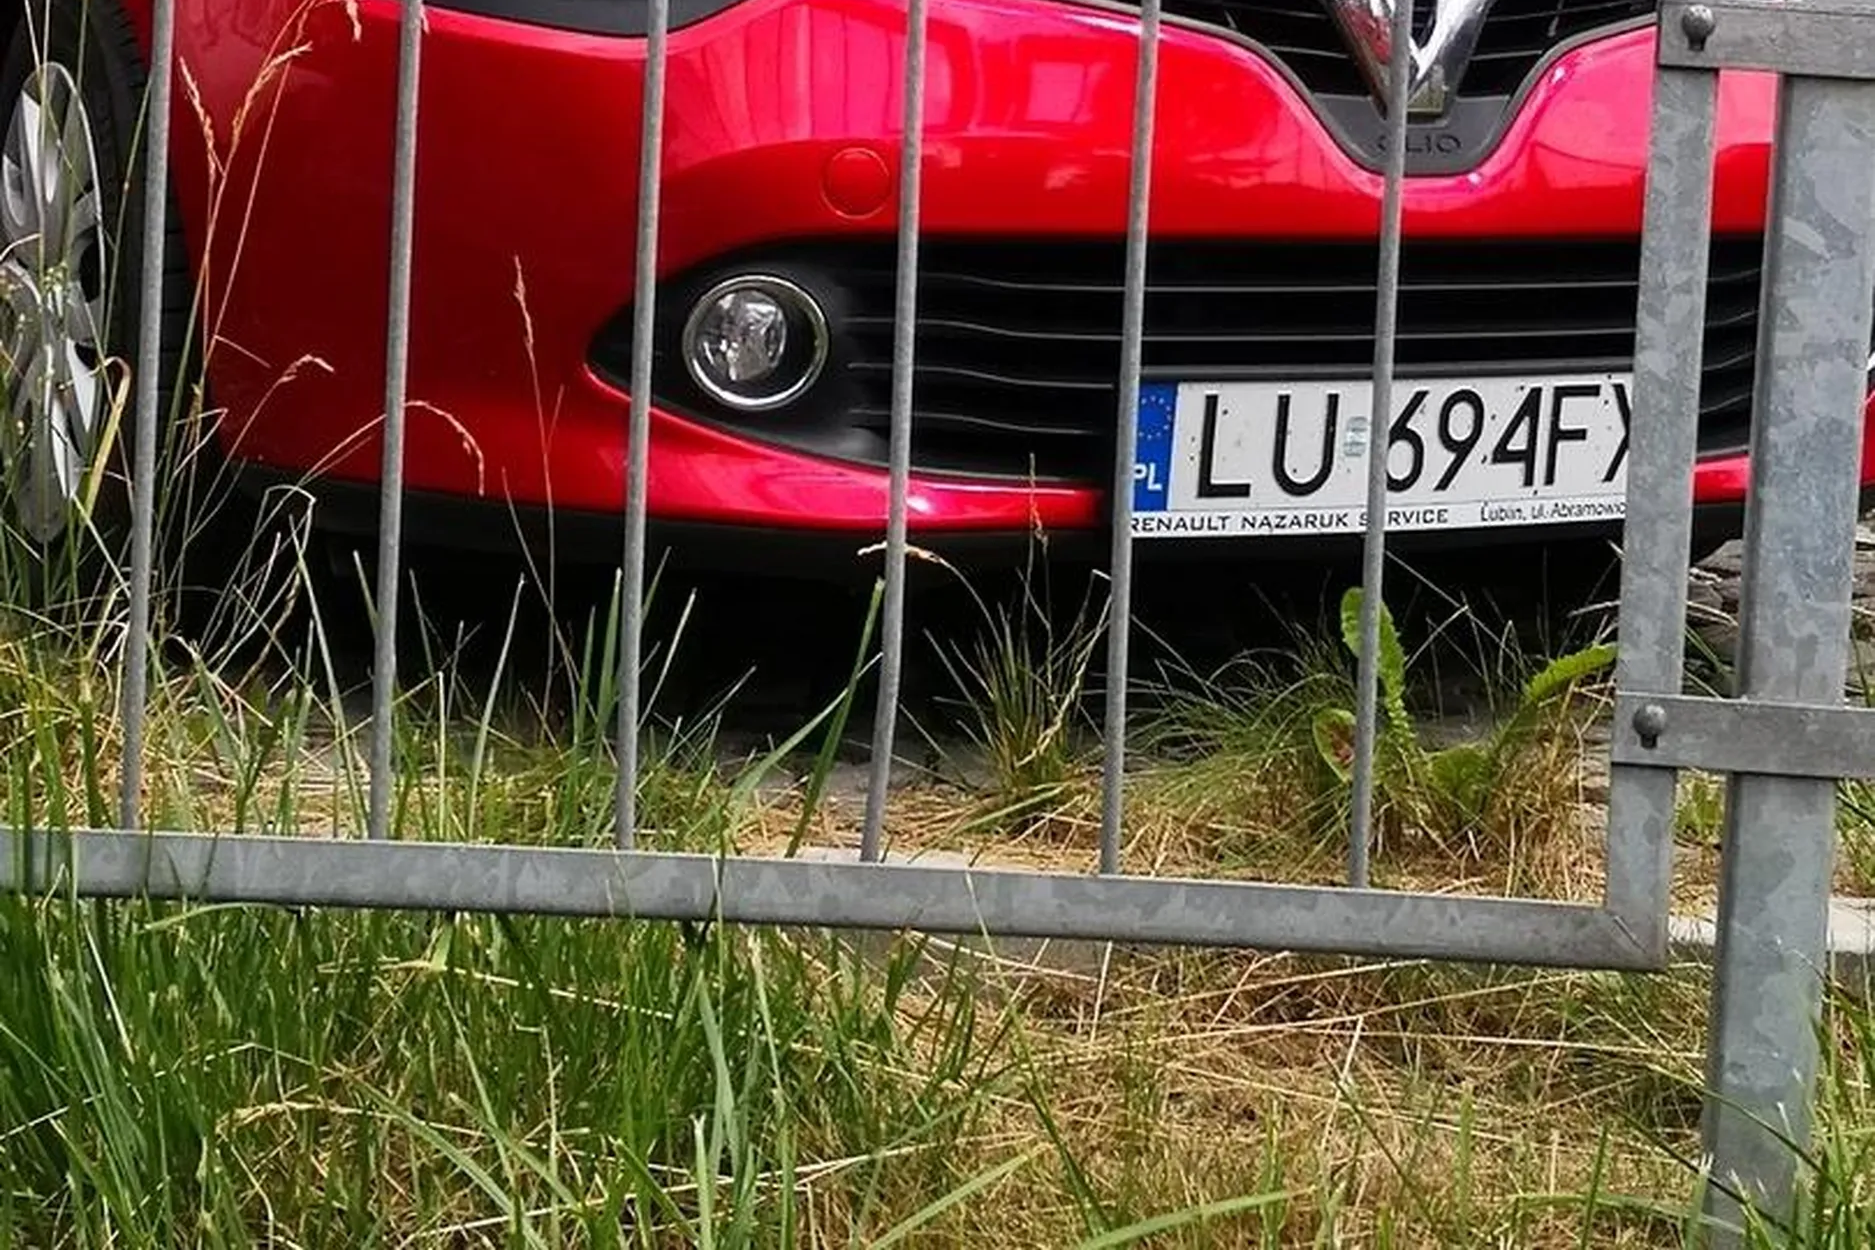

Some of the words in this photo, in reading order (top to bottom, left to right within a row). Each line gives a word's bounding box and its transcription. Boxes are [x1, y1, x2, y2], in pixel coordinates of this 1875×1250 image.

[1195, 393, 1340, 498] LU
[1133, 462, 1163, 491] PL
[1130, 515, 1231, 532] RENAULT
[1241, 512, 1349, 530] NAZARUK
[1358, 509, 1449, 527] SRVICE
